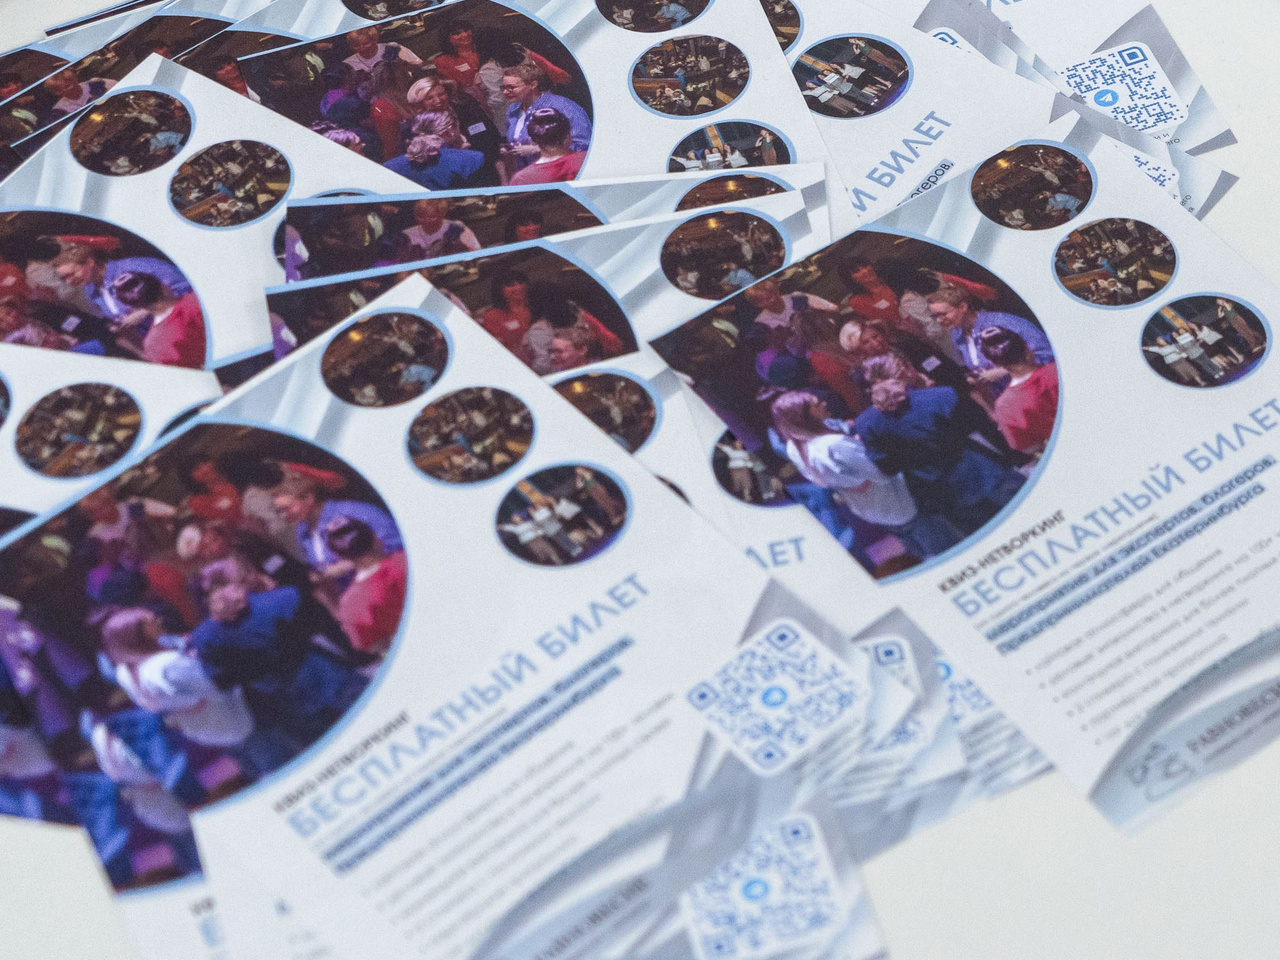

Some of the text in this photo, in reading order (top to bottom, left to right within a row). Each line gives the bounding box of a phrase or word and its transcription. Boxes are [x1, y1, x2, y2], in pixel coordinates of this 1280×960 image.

[865, 110, 952, 189] БИЛЕТ
[936, 508, 1069, 594] КВИЗ-НЕТВОРКИНГ
[947, 462, 1187, 619] БЕСПЛАТНЫЙ
[280, 649, 543, 839] БЕСПЛАТНЫЙ
[532, 571, 657, 661] БИЛЕТ
